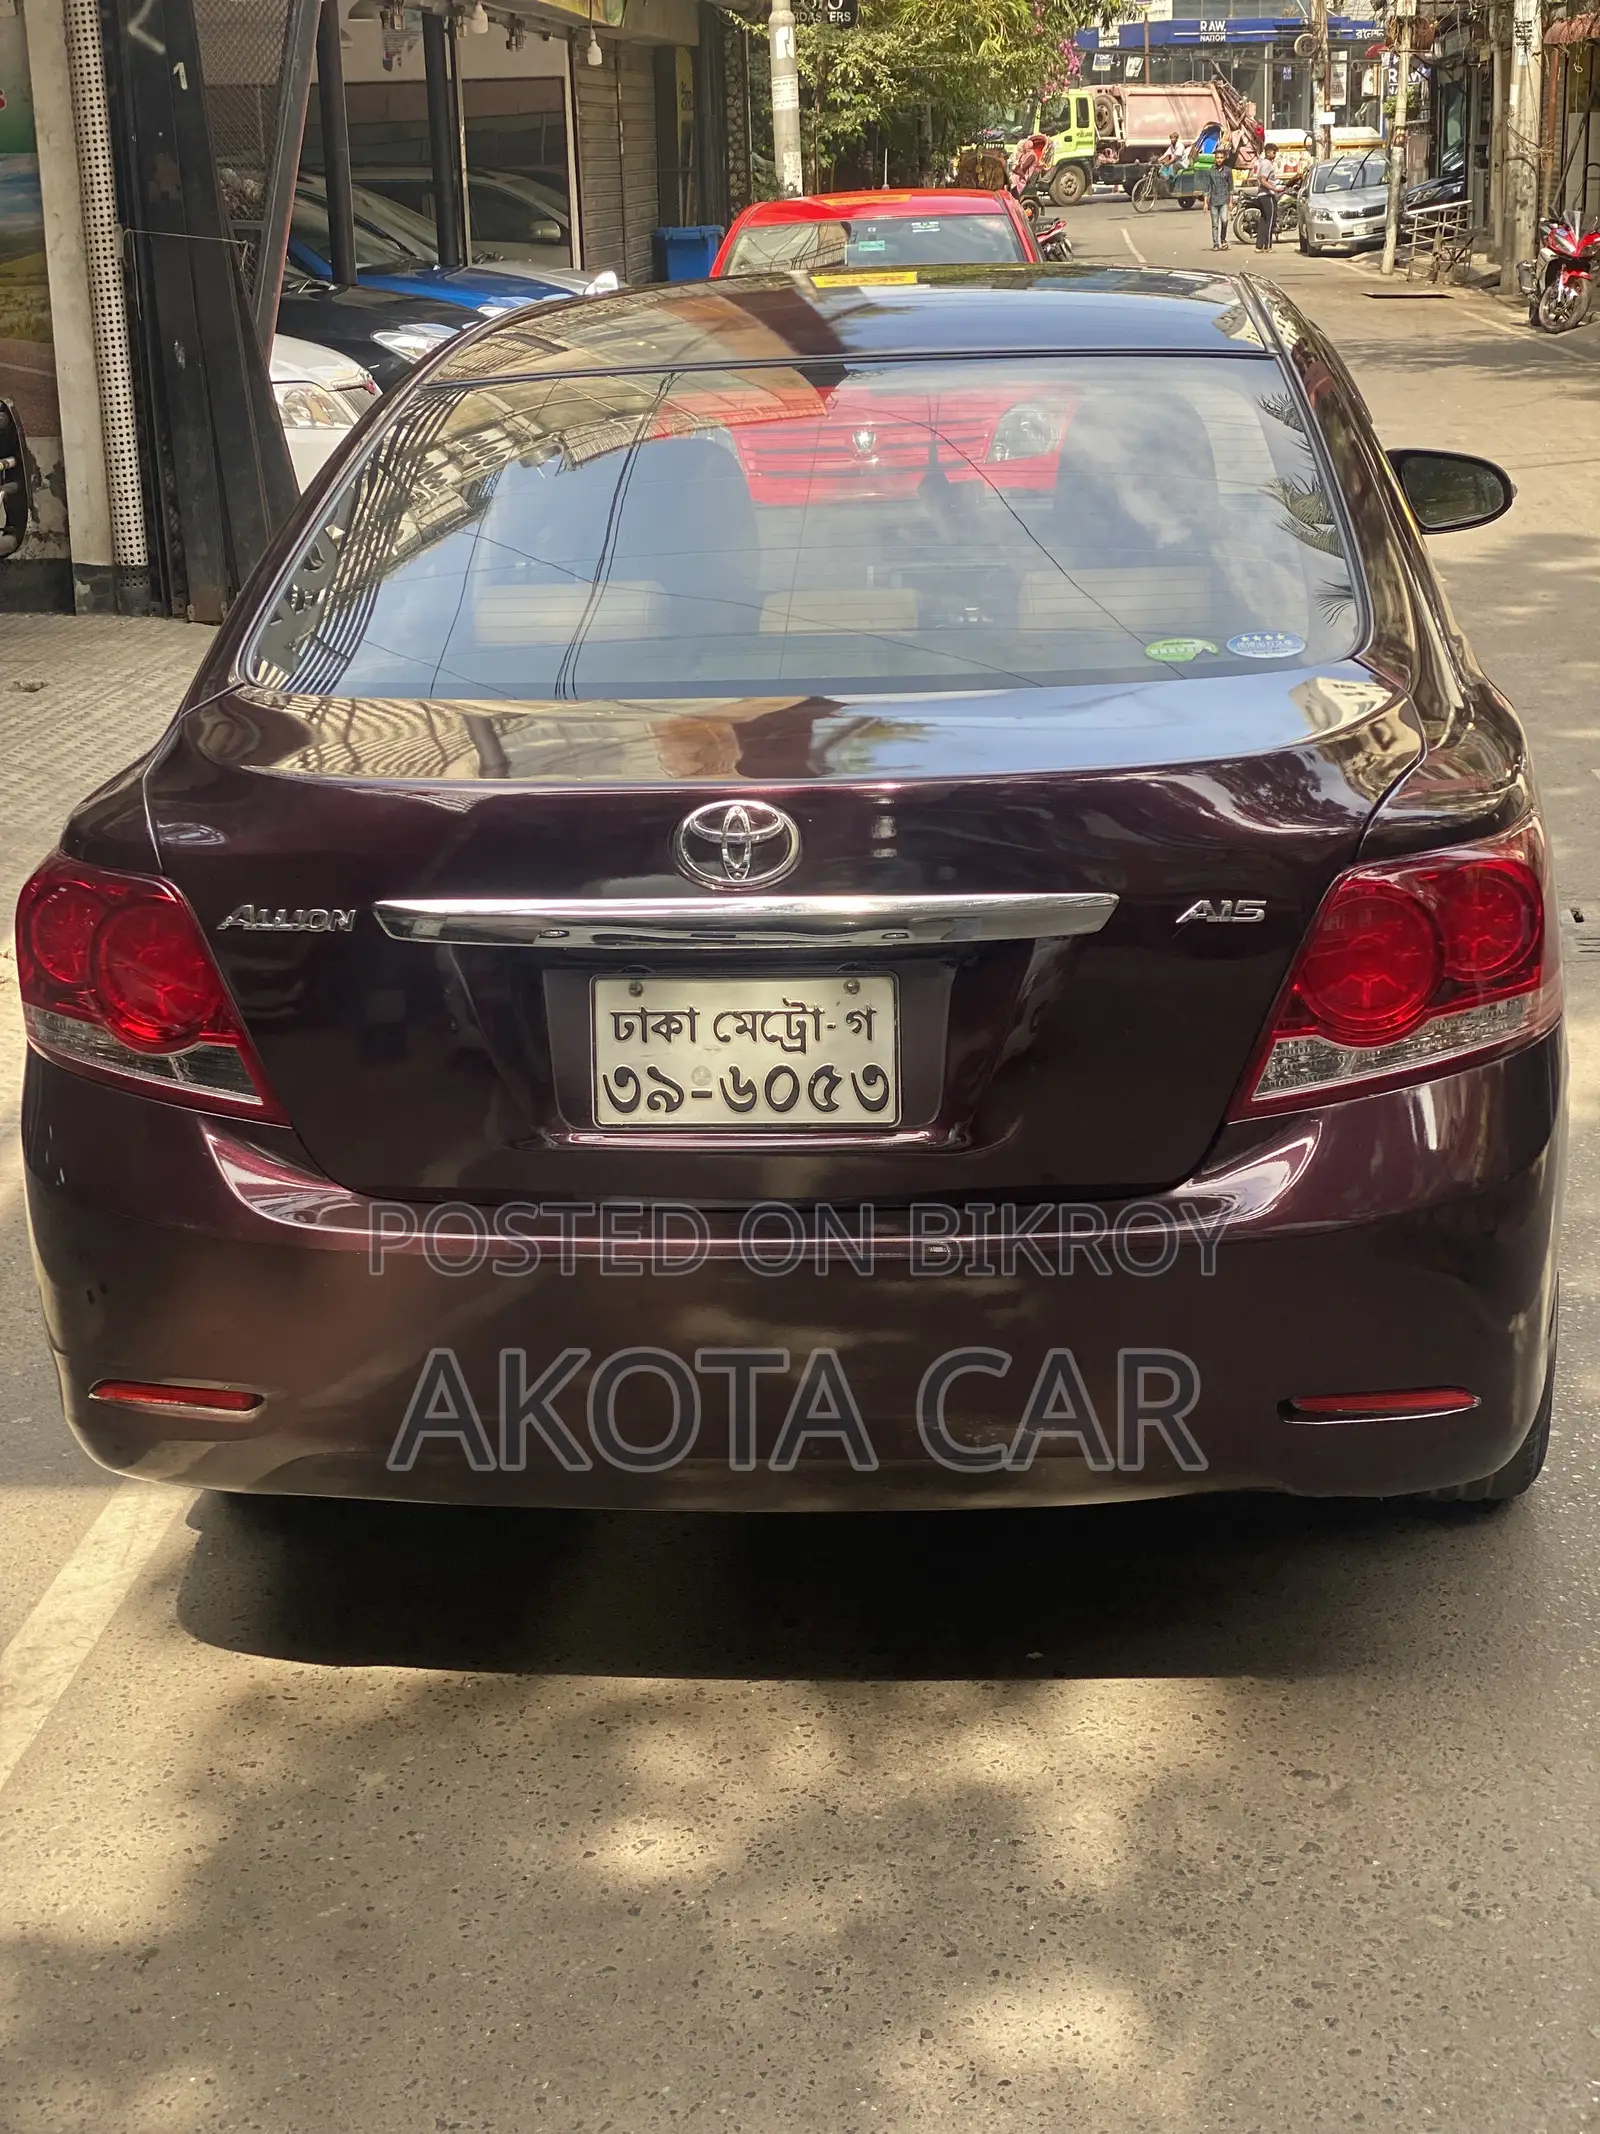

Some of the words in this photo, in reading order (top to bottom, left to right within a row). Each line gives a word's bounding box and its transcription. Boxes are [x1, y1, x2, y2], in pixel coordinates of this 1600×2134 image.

[1175, 899, 1267, 923] A15
[609, 1006, 700, 1043] ঢাকা
[602, 1063, 890, 1114] ৩৯-৬০৫৩
